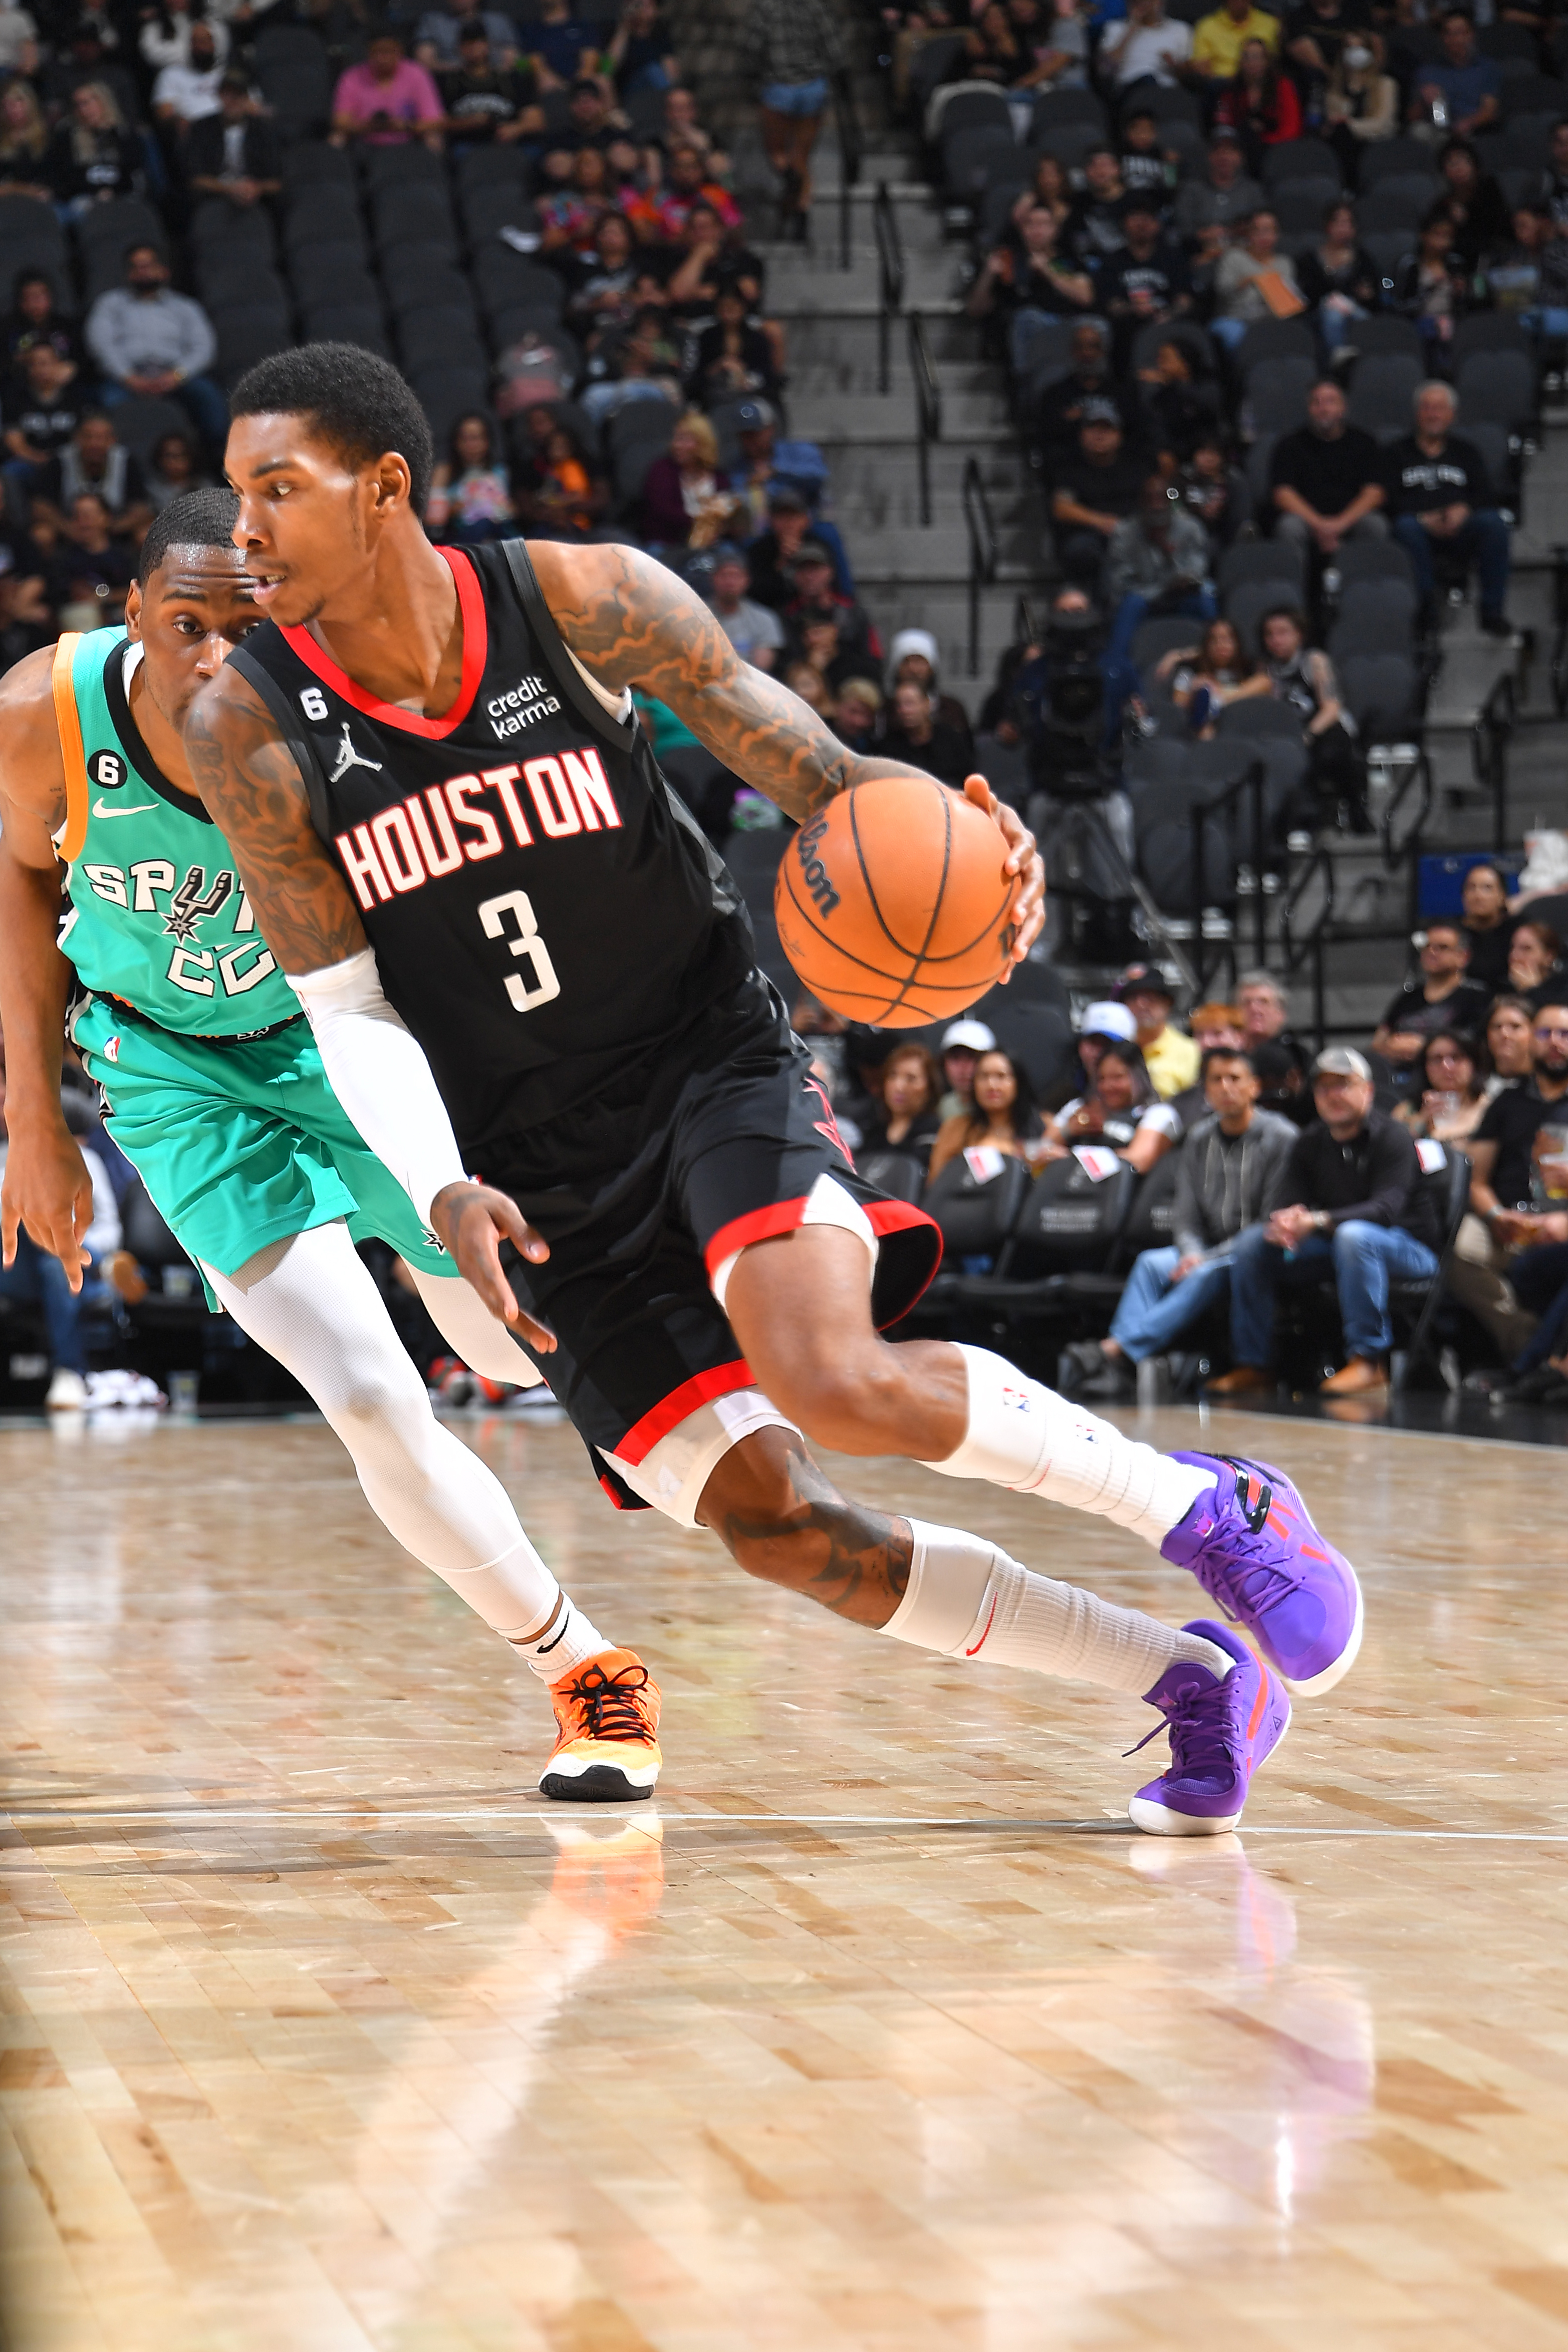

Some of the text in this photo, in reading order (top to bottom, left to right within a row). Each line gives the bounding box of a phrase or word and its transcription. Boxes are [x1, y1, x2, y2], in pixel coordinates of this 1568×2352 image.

[299, 687, 329, 722] 6
[487, 676, 548, 717] credit
[489, 696, 562, 740] karma
[98, 755, 119, 786] 6
[334, 747, 623, 912] HOUSTON
[477, 889, 562, 1013] 3
